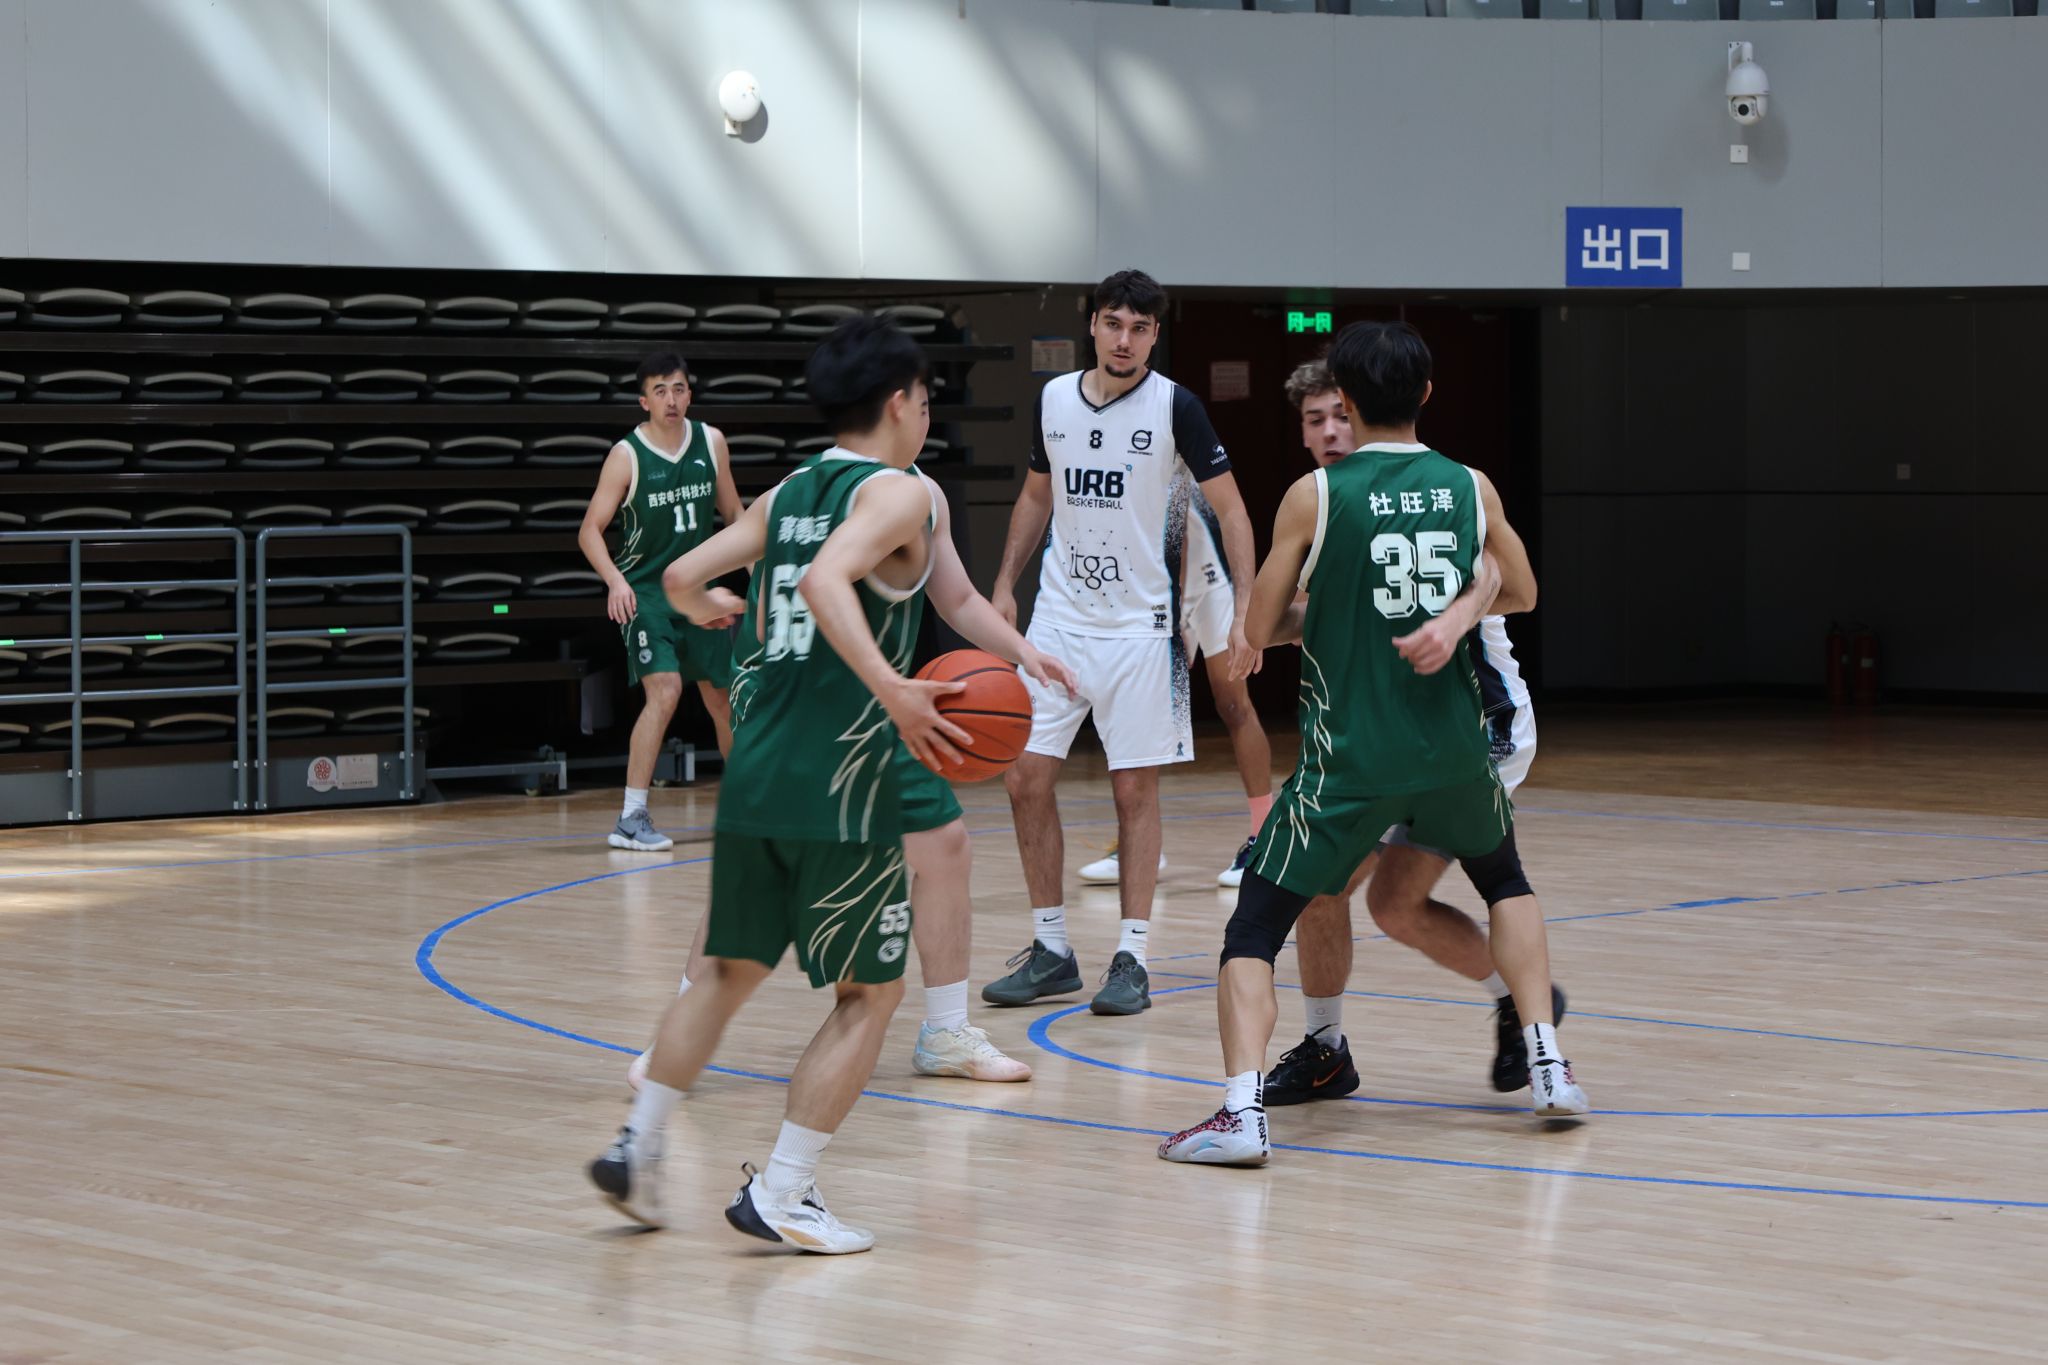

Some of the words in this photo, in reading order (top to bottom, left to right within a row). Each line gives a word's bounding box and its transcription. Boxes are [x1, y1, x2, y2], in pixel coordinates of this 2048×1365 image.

[1582, 224, 1669, 271] 出口
[1090, 429, 1103, 449] 8
[647, 481, 712, 508] 西安电子科技大学
[1065, 467, 1125, 498] URB
[1066, 496, 1123, 510] BASKETBALL
[1369, 488, 1454, 516] 杜旺泽
[673, 502, 698, 533] 11
[1370, 531, 1462, 619] 35
[638, 630, 648, 647] 8
[878, 900, 911, 936] 55
